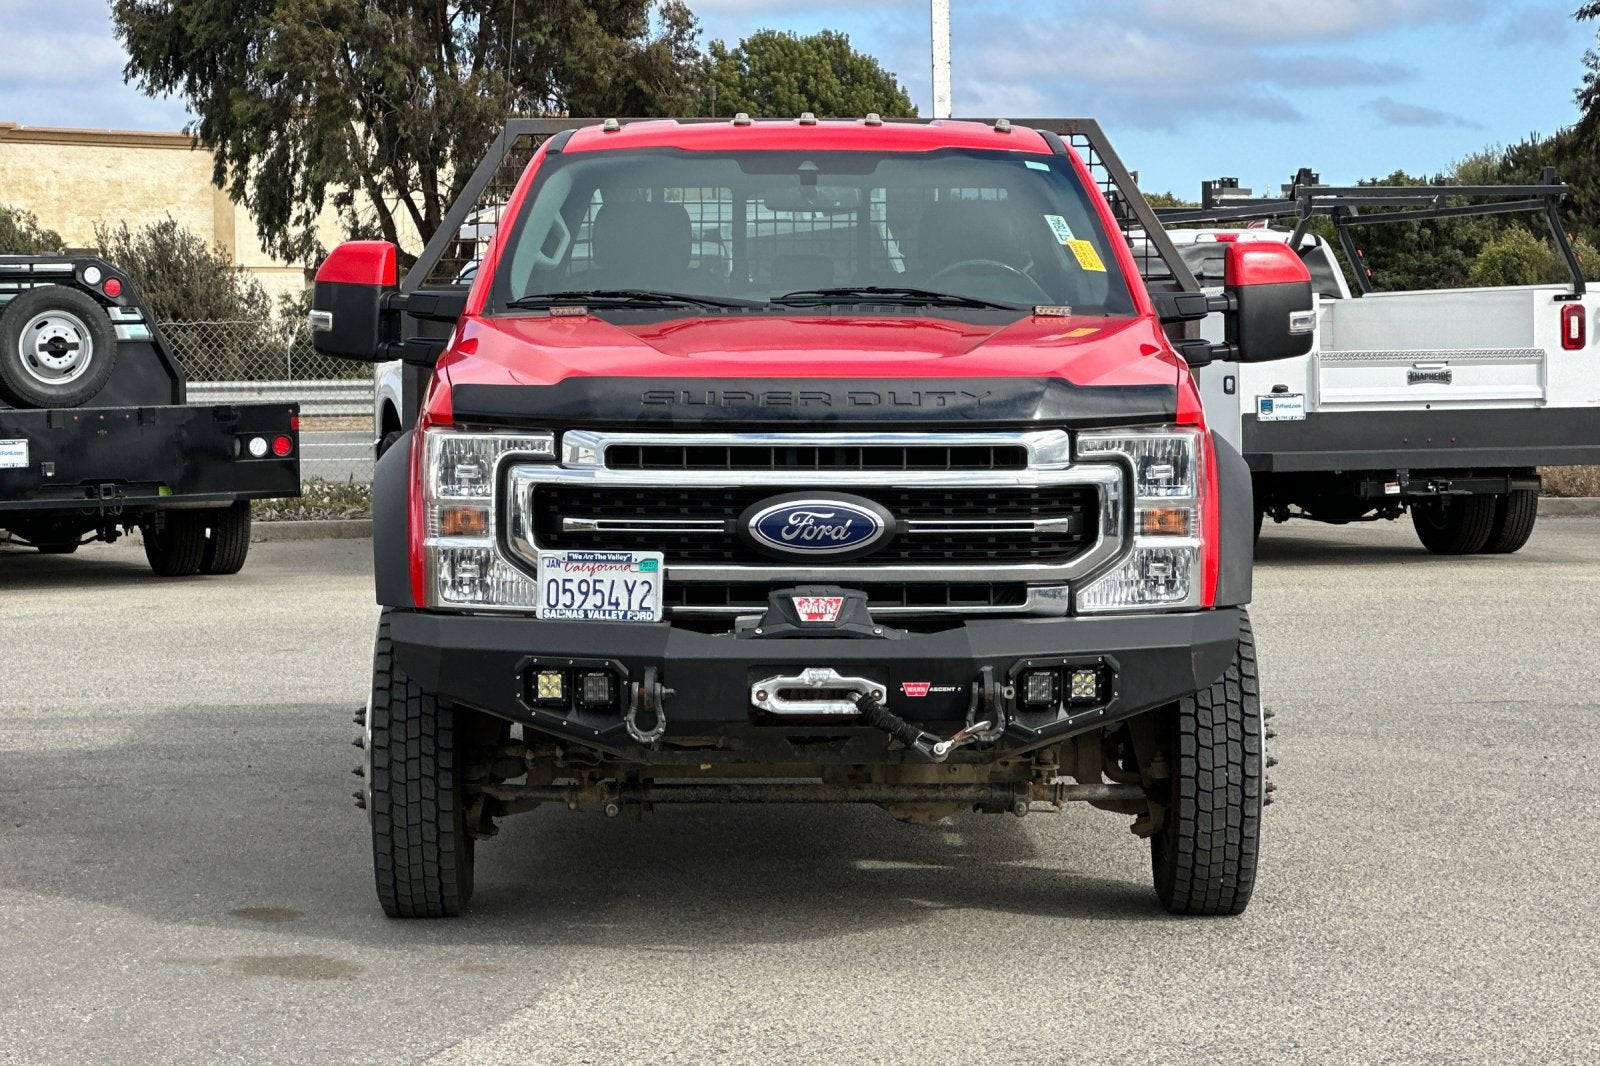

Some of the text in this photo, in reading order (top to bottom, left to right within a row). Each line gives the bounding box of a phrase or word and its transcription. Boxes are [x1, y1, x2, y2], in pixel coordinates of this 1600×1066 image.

[641, 390, 992, 407] SUPER DUTY
[781, 511, 852, 541] Ford
[546, 560, 561, 569] JAN
[564, 561, 634, 577] California
[547, 578, 653, 611] 05954Y2
[587, 610, 624, 619] VALLEY
